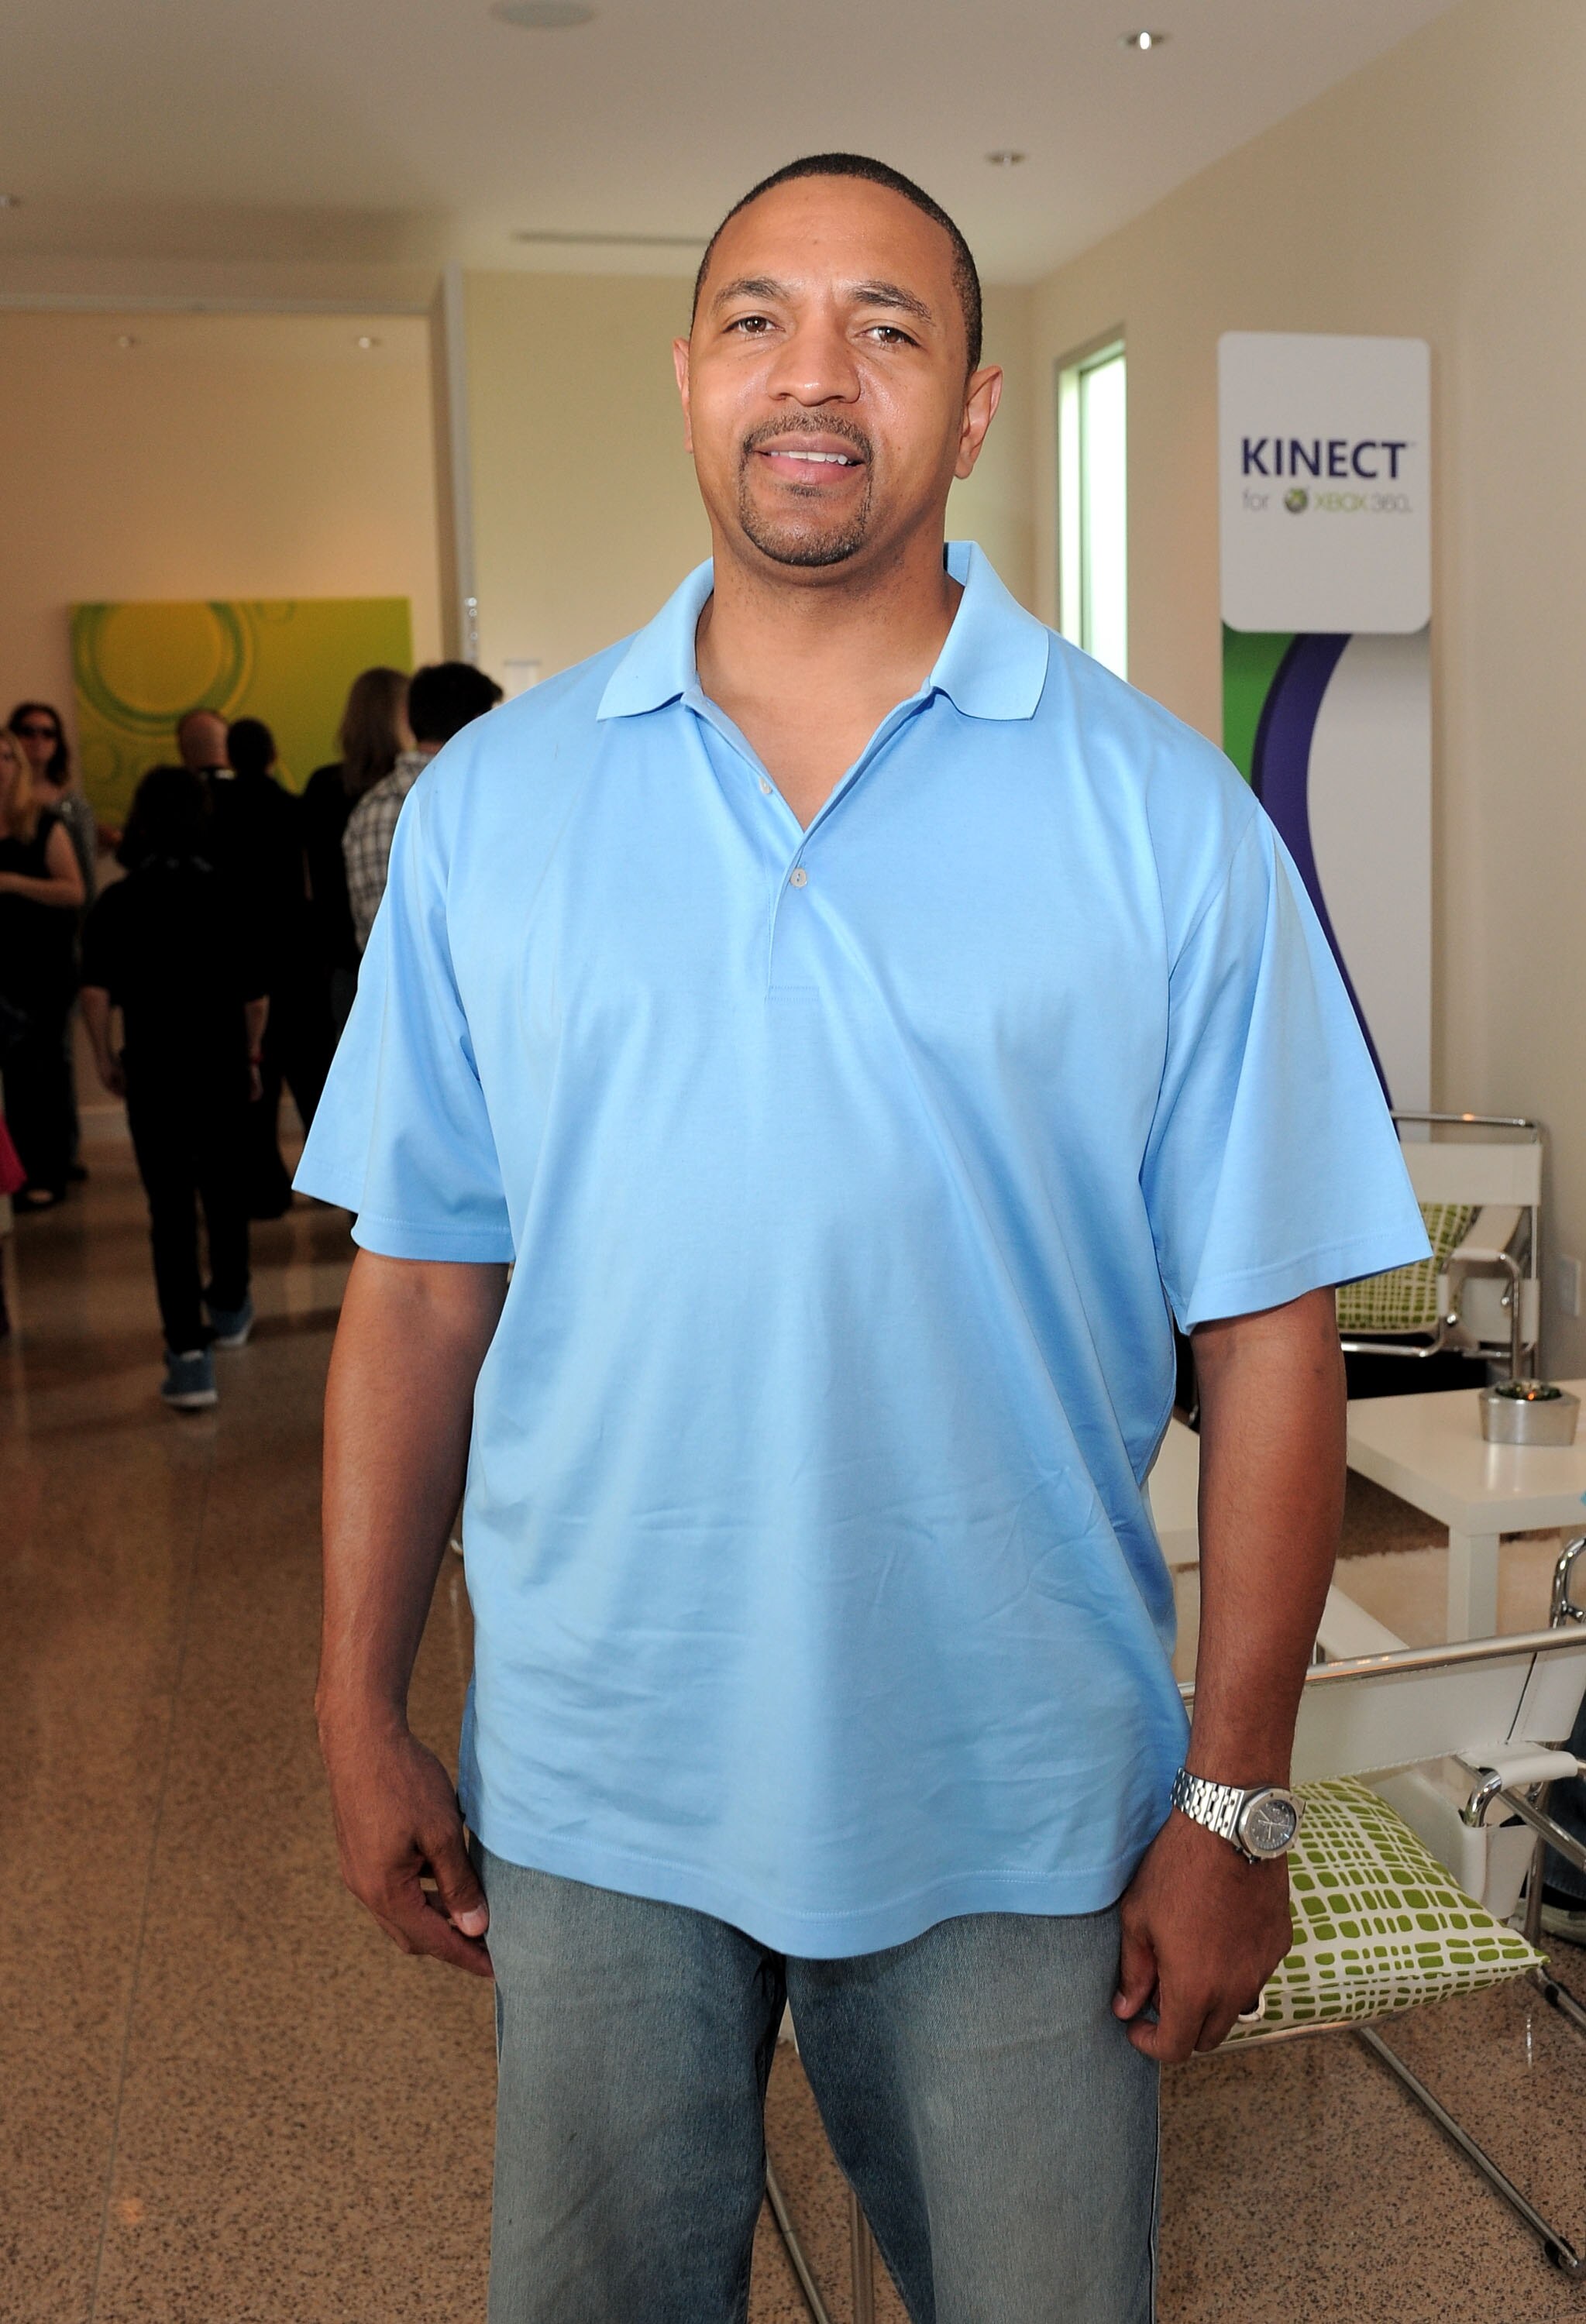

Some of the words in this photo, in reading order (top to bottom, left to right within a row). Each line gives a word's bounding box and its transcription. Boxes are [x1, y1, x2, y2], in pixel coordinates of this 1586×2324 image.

[1242, 438, 1407, 479] KINECT
[1243, 488, 1270, 511] for
[1314, 492, 1368, 513] XBOX
